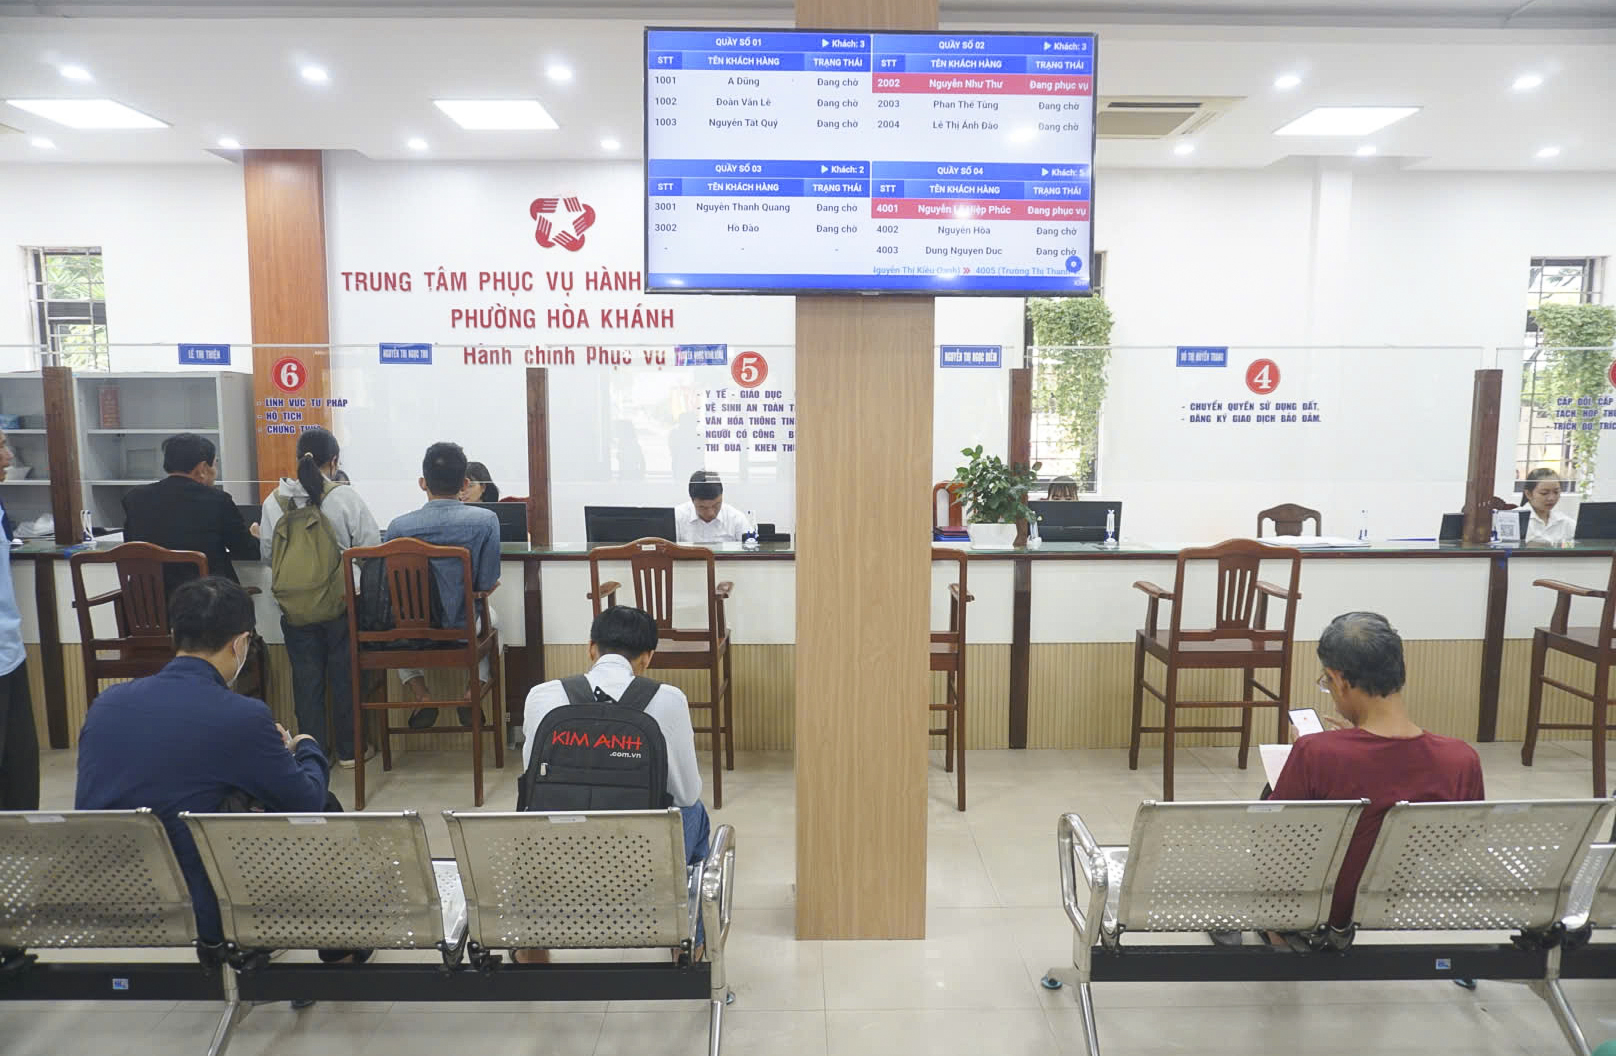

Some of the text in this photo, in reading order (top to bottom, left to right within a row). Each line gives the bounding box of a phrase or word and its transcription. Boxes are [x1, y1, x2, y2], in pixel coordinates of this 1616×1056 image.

[715, 36, 762, 47] QUẦY SỐ 01
[832, 39, 865, 48] Khách: 3
[938, 40, 985, 50] QUẦY SỐ 02
[1054, 42, 1087, 51] Khách: 3
[657, 56, 674, 65] STT
[708, 55, 780, 66] TÊN KHÁCH HÀNG
[813, 57, 863, 68] TRẠNG THÁI
[881, 59, 897, 67] STT
[931, 59, 1003, 69] TÊN KHÁCH HÀNG
[1036, 60, 1084, 71] TRẠNG THÁI
[655, 76, 676, 84] 1001
[728, 77, 734, 85] A
[817, 78, 839, 88] Đang
[877, 78, 900, 87] 2002
[929, 78, 1003, 90] Nguyễn Như Thư
[1029, 80, 1089, 92] Đang phục vụ
[655, 97, 677, 106] 1002
[817, 99, 839, 109] Đang
[877, 99, 900, 108] 2003
[933, 100, 956, 109] Phan
[1038, 102, 1061, 112] Đang
[655, 118, 677, 127] 1003
[817, 119, 839, 129] Đang
[877, 120, 900, 129] 2004
[945, 121, 960, 131] Thị
[962, 120, 979, 130] Ánh
[715, 162, 762, 174] QUẦY SỐ 03
[831, 165, 865, 174] Khách: 2
[937, 165, 984, 176] QUẦY SỐ 04
[657, 183, 674, 191] STT
[707, 182, 779, 192] TÊN KHÁCH HÀNG
[813, 183, 862, 194] TRẠNG THÁI
[879, 185, 896, 193] STT
[929, 184, 1000, 195] TÊN KHÁCH HÀNG
[1033, 185, 1082, 197] TRẠNG THÁI
[654, 203, 676, 211] 3001
[732, 203, 760, 211] Thanh
[761, 203, 791, 213] Quang
[816, 203, 839, 213] Đang
[876, 204, 898, 213] 4001
[918, 203, 1012, 215] Nguyễn Phúc
[1027, 206, 1087, 217] Đang phục vụ
[654, 224, 677, 232] 3002
[816, 225, 839, 235] Đang
[876, 225, 899, 234] 4002
[1036, 227, 1059, 237] Đang
[876, 246, 899, 255] 4003
[925, 247, 948, 257] Dung
[986, 247, 1003, 256] Duc
[1036, 247, 1059, 258] Đang
[975, 266, 996, 275] 4005
[341, 265, 642, 297] TRUNG TÂM PHỤC VỤ HÀNH
[451, 303, 675, 329] PHƯỜNG HÒA KHÁNH
[740, 357, 759, 382] 5
[280, 362, 299, 388] 6
[1253, 364, 1272, 389] 4
[705, 388, 782, 400] Y TẾ GIÁO DỤC
[705, 402, 784, 413] VỆ SINH AN TOÀN
[1190, 400, 1297, 412] CHUYỂN QUYỀN SỬ DỤNG
[705, 415, 722, 425] VĂN
[727, 415, 744, 425] HÓA
[748, 415, 776, 425] THÔNG
[1190, 413, 1297, 424] ĐĂNG KÝ GIAO DỊCH BẢO
[705, 429, 775, 438] NGƯỜI CÓ CÔNG
[705, 443, 777, 452] THI ĐUA KHEN
[552, 730, 643, 751] KIM ANH
[609, 751, 642, 759] .com.vn
